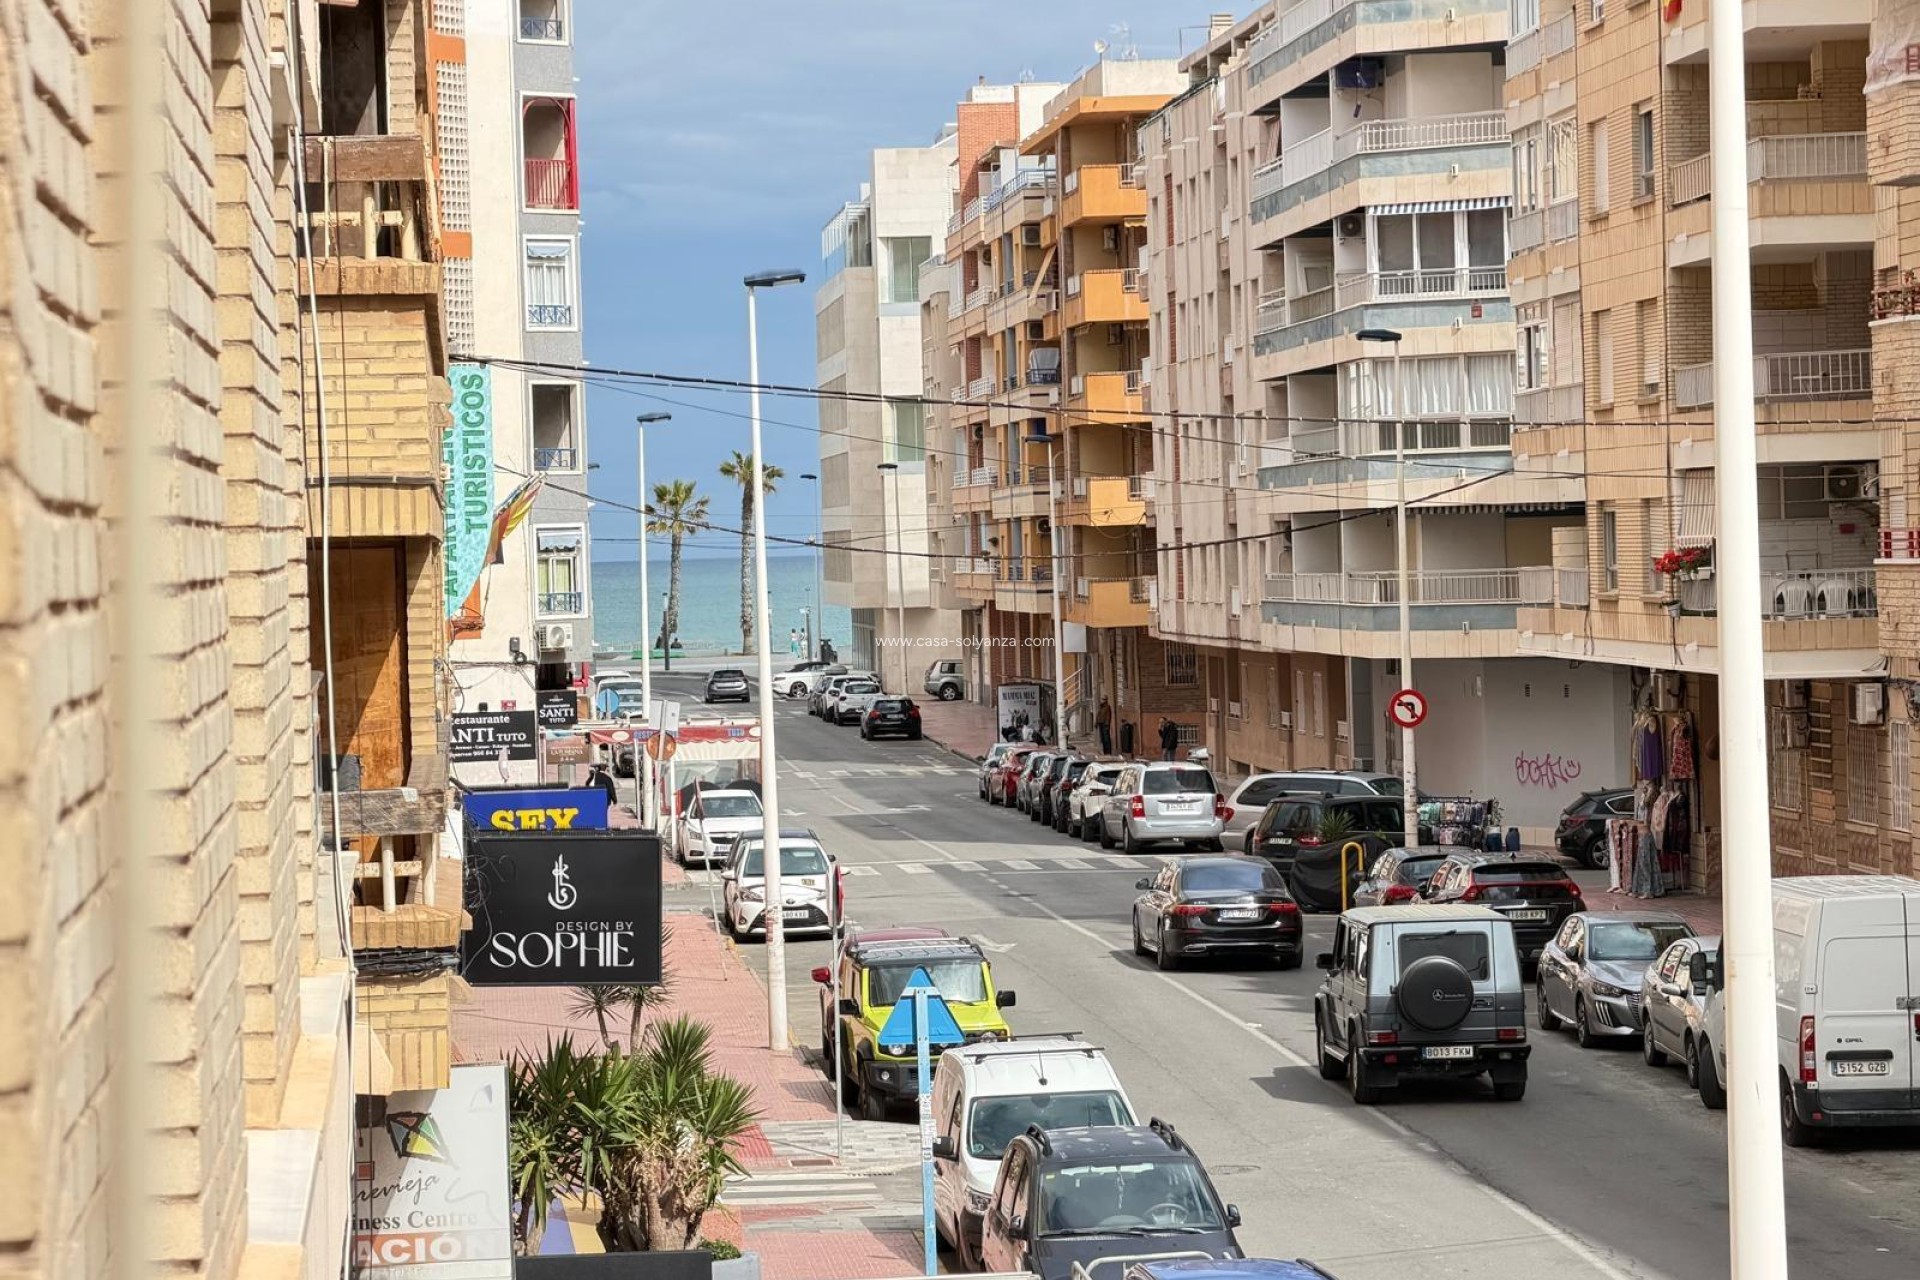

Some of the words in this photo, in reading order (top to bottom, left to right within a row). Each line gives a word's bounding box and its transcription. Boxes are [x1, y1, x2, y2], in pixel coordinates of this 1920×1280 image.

[461, 374, 488, 534] TURISTICOS
[540, 708, 574, 718] SANTI
[496, 732, 527, 742] TUTO
[556, 921, 609, 931] DESIGN
[616, 921, 634, 931] BY
[490, 932, 635, 968] SOPHIE
[1427, 1048, 1450, 1057] 8013
[1840, 1063, 1863, 1073] 5152
[408, 1211, 477, 1229] Centre
